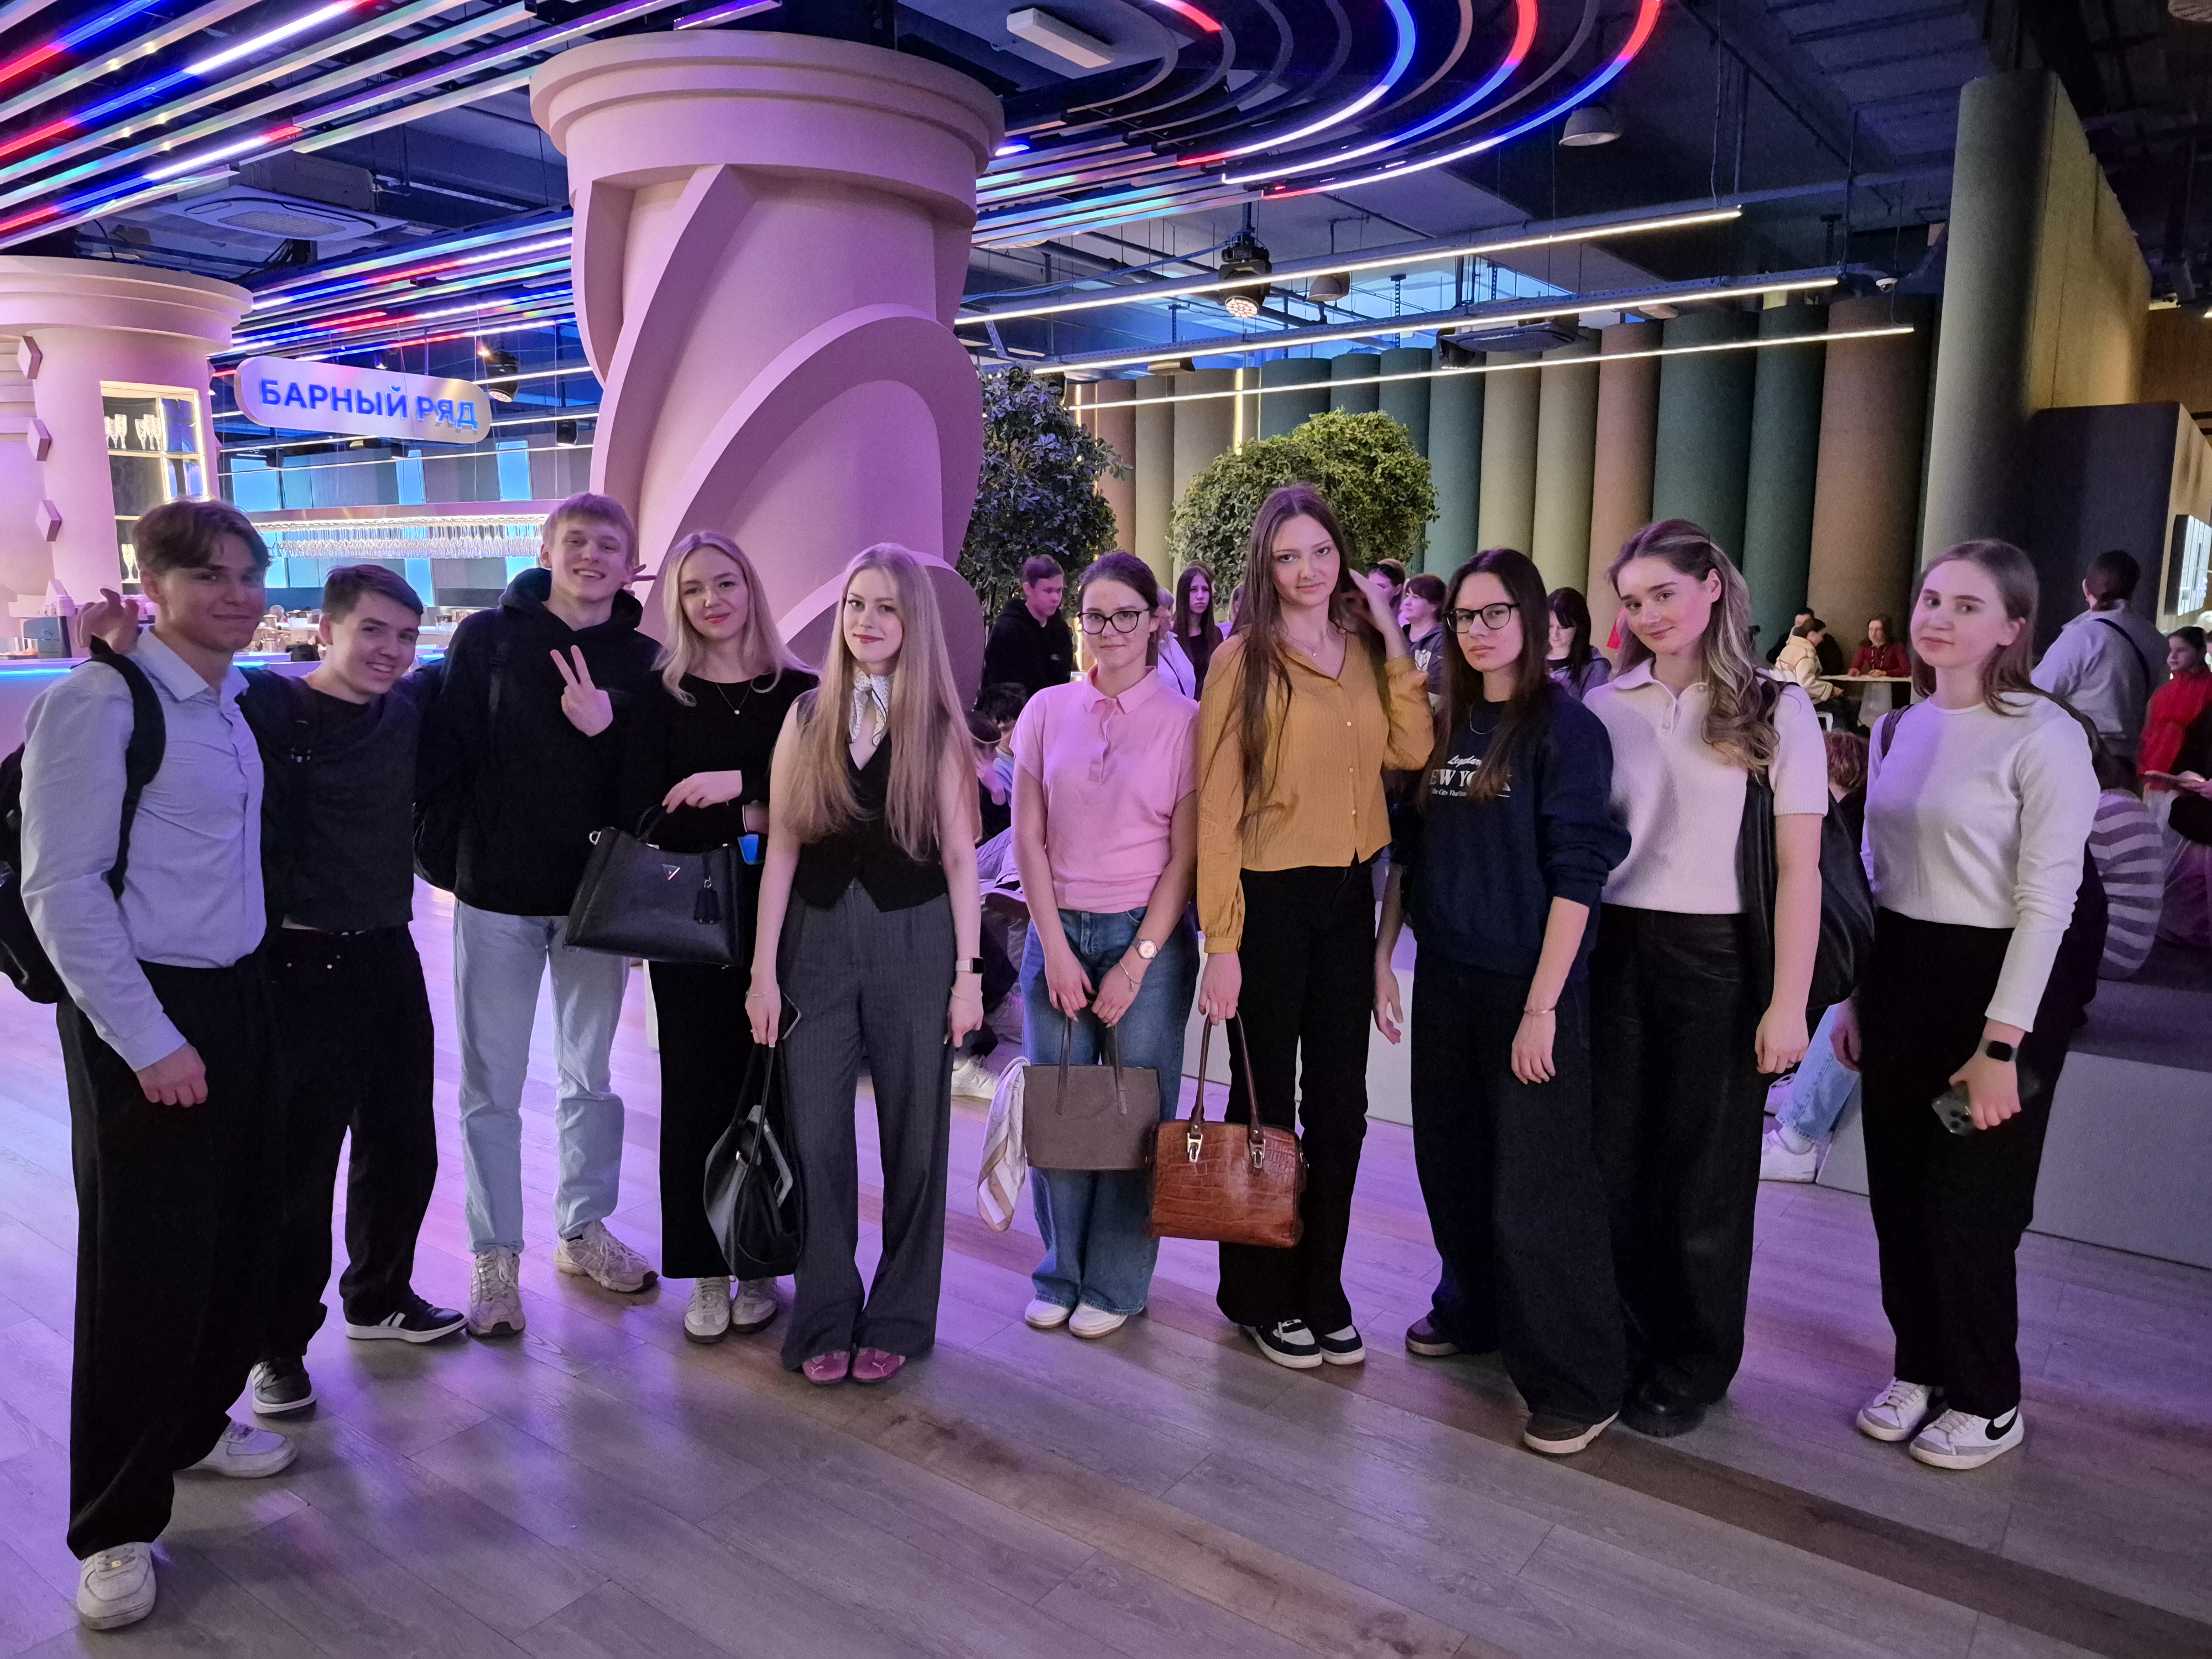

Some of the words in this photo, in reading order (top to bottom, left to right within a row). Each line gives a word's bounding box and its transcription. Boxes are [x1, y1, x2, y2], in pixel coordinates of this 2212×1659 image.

[260, 378, 408, 419] БАРНЫЙ
[416, 395, 479, 431] РЯД
[1428, 769, 1457, 786] EW
